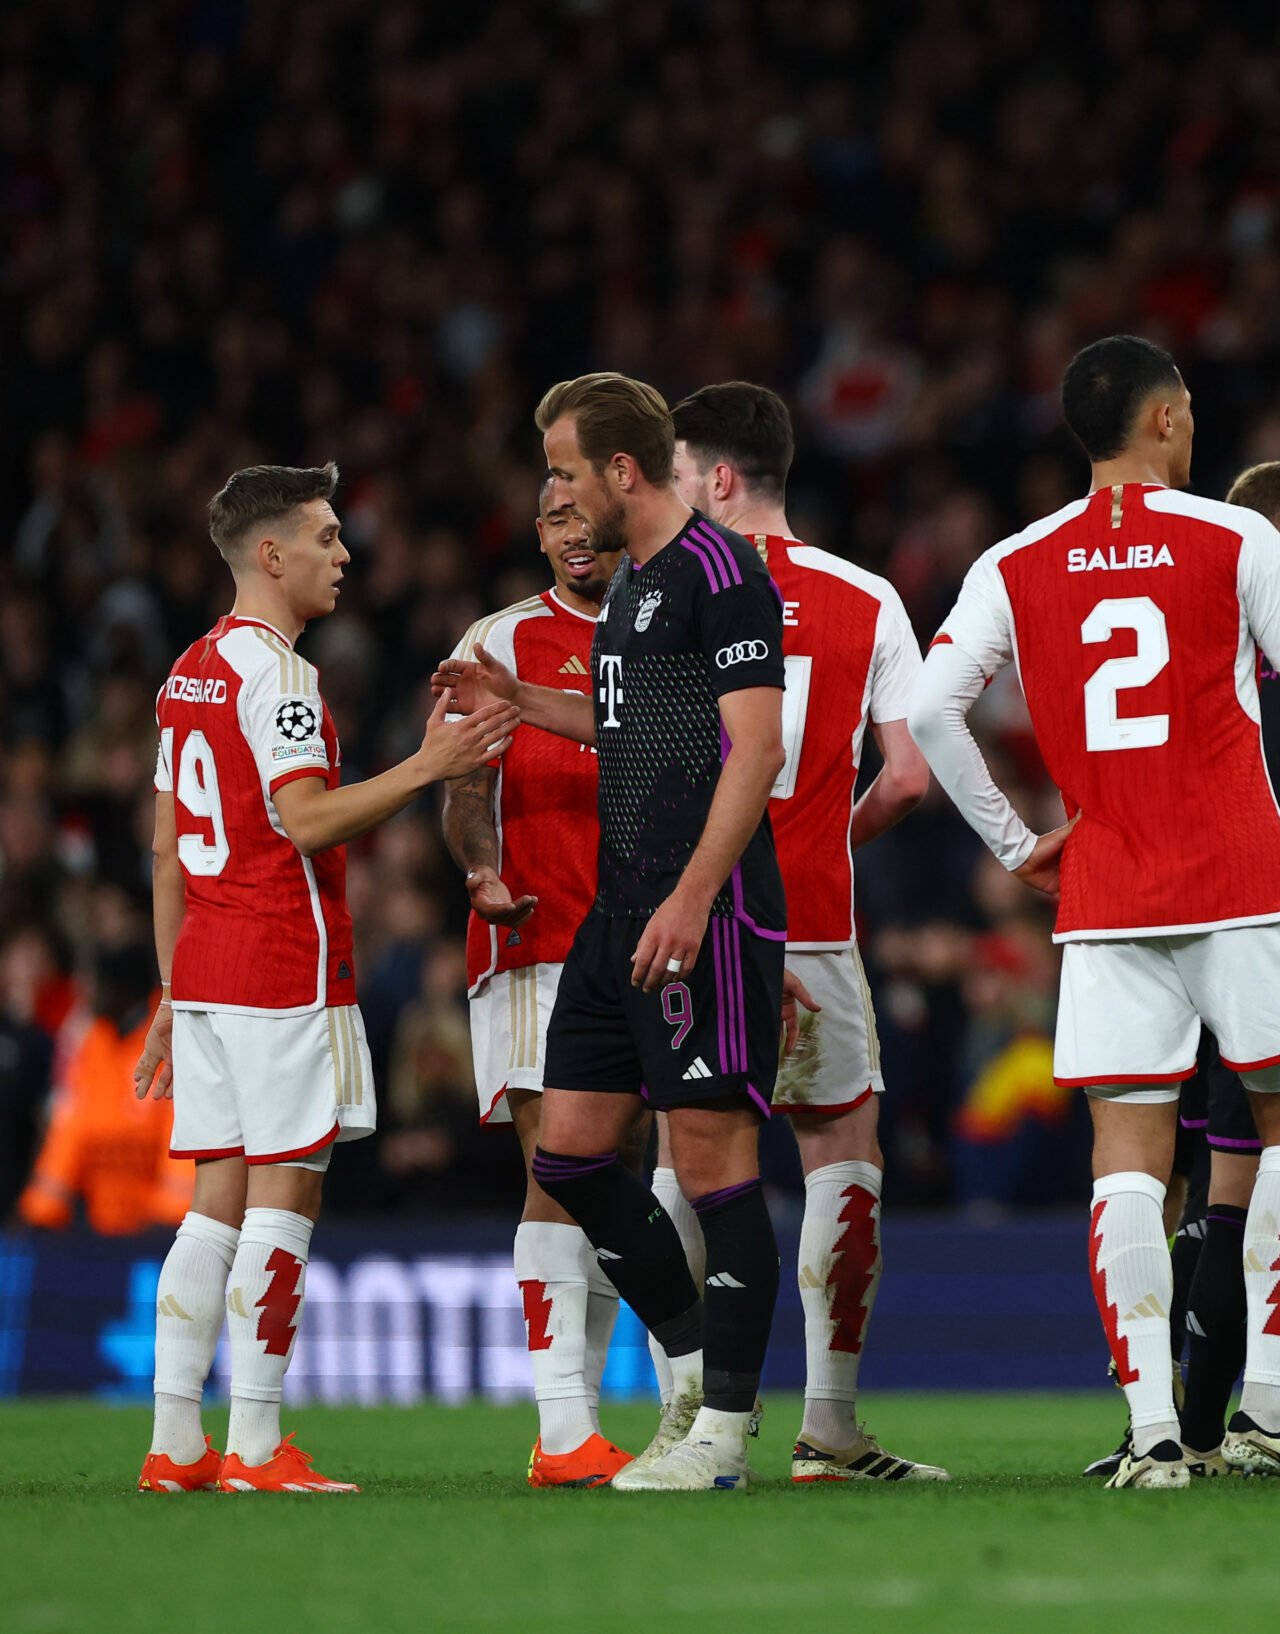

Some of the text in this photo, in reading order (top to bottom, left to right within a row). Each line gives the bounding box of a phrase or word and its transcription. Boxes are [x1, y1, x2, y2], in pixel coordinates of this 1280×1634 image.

[1067, 543, 1175, 573] SALIBA
[1080, 596, 1170, 752] 2
[272, 746, 326, 758] FOUNDATION
[660, 981, 694, 1050] 9
